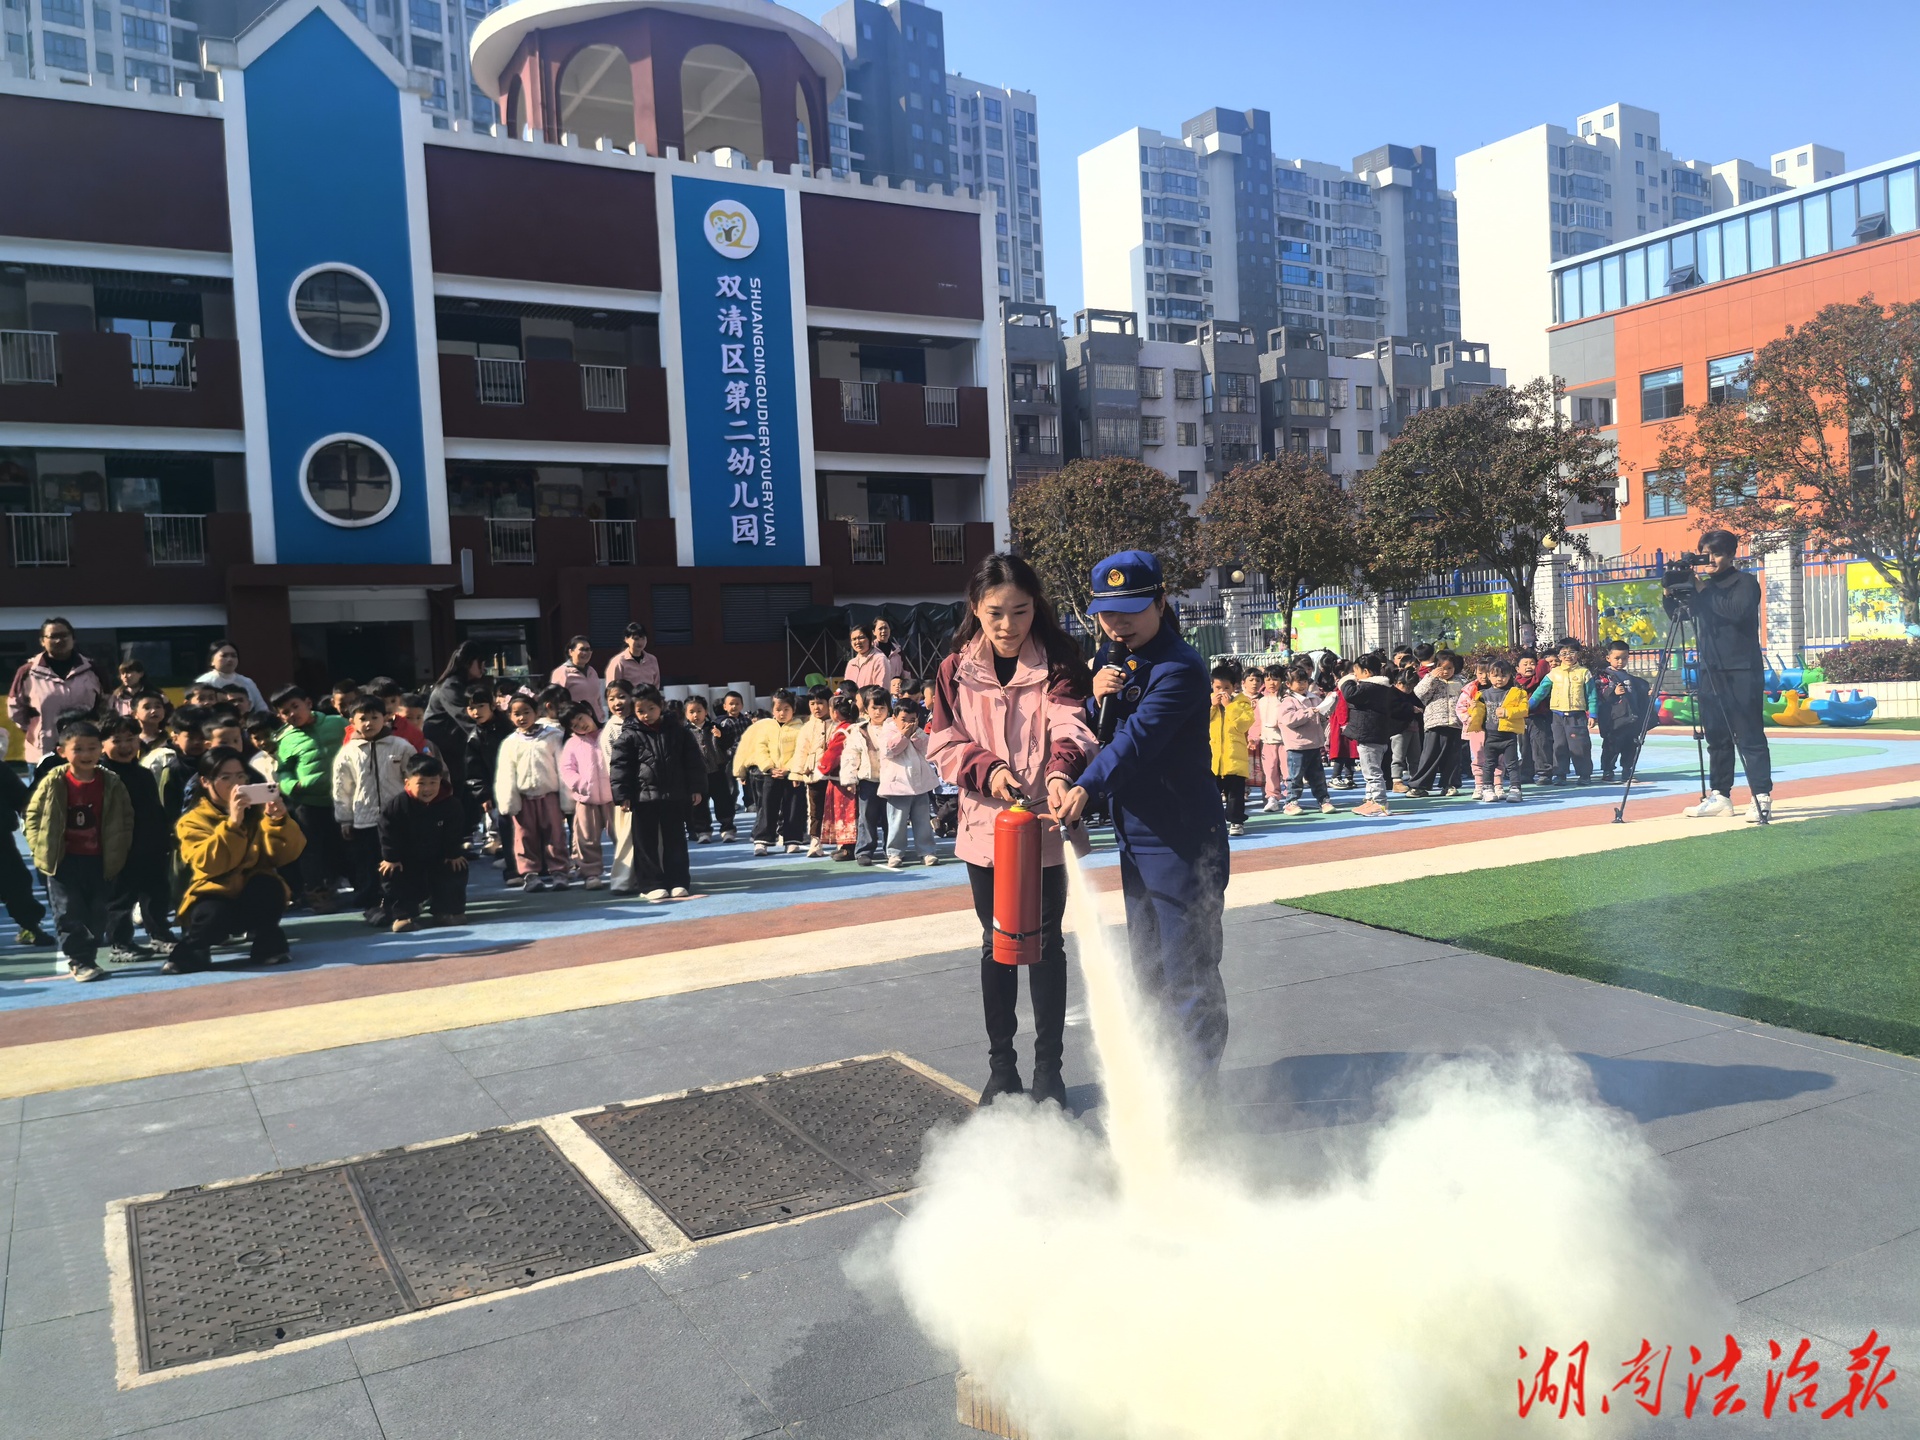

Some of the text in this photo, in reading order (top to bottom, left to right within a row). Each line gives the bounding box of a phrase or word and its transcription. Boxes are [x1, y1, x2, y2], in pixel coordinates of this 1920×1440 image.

[715, 275, 760, 545] 双清区第二幼儿园
[750, 277, 776, 546] SHUANGQINGQUDIERYOUERYUAN
